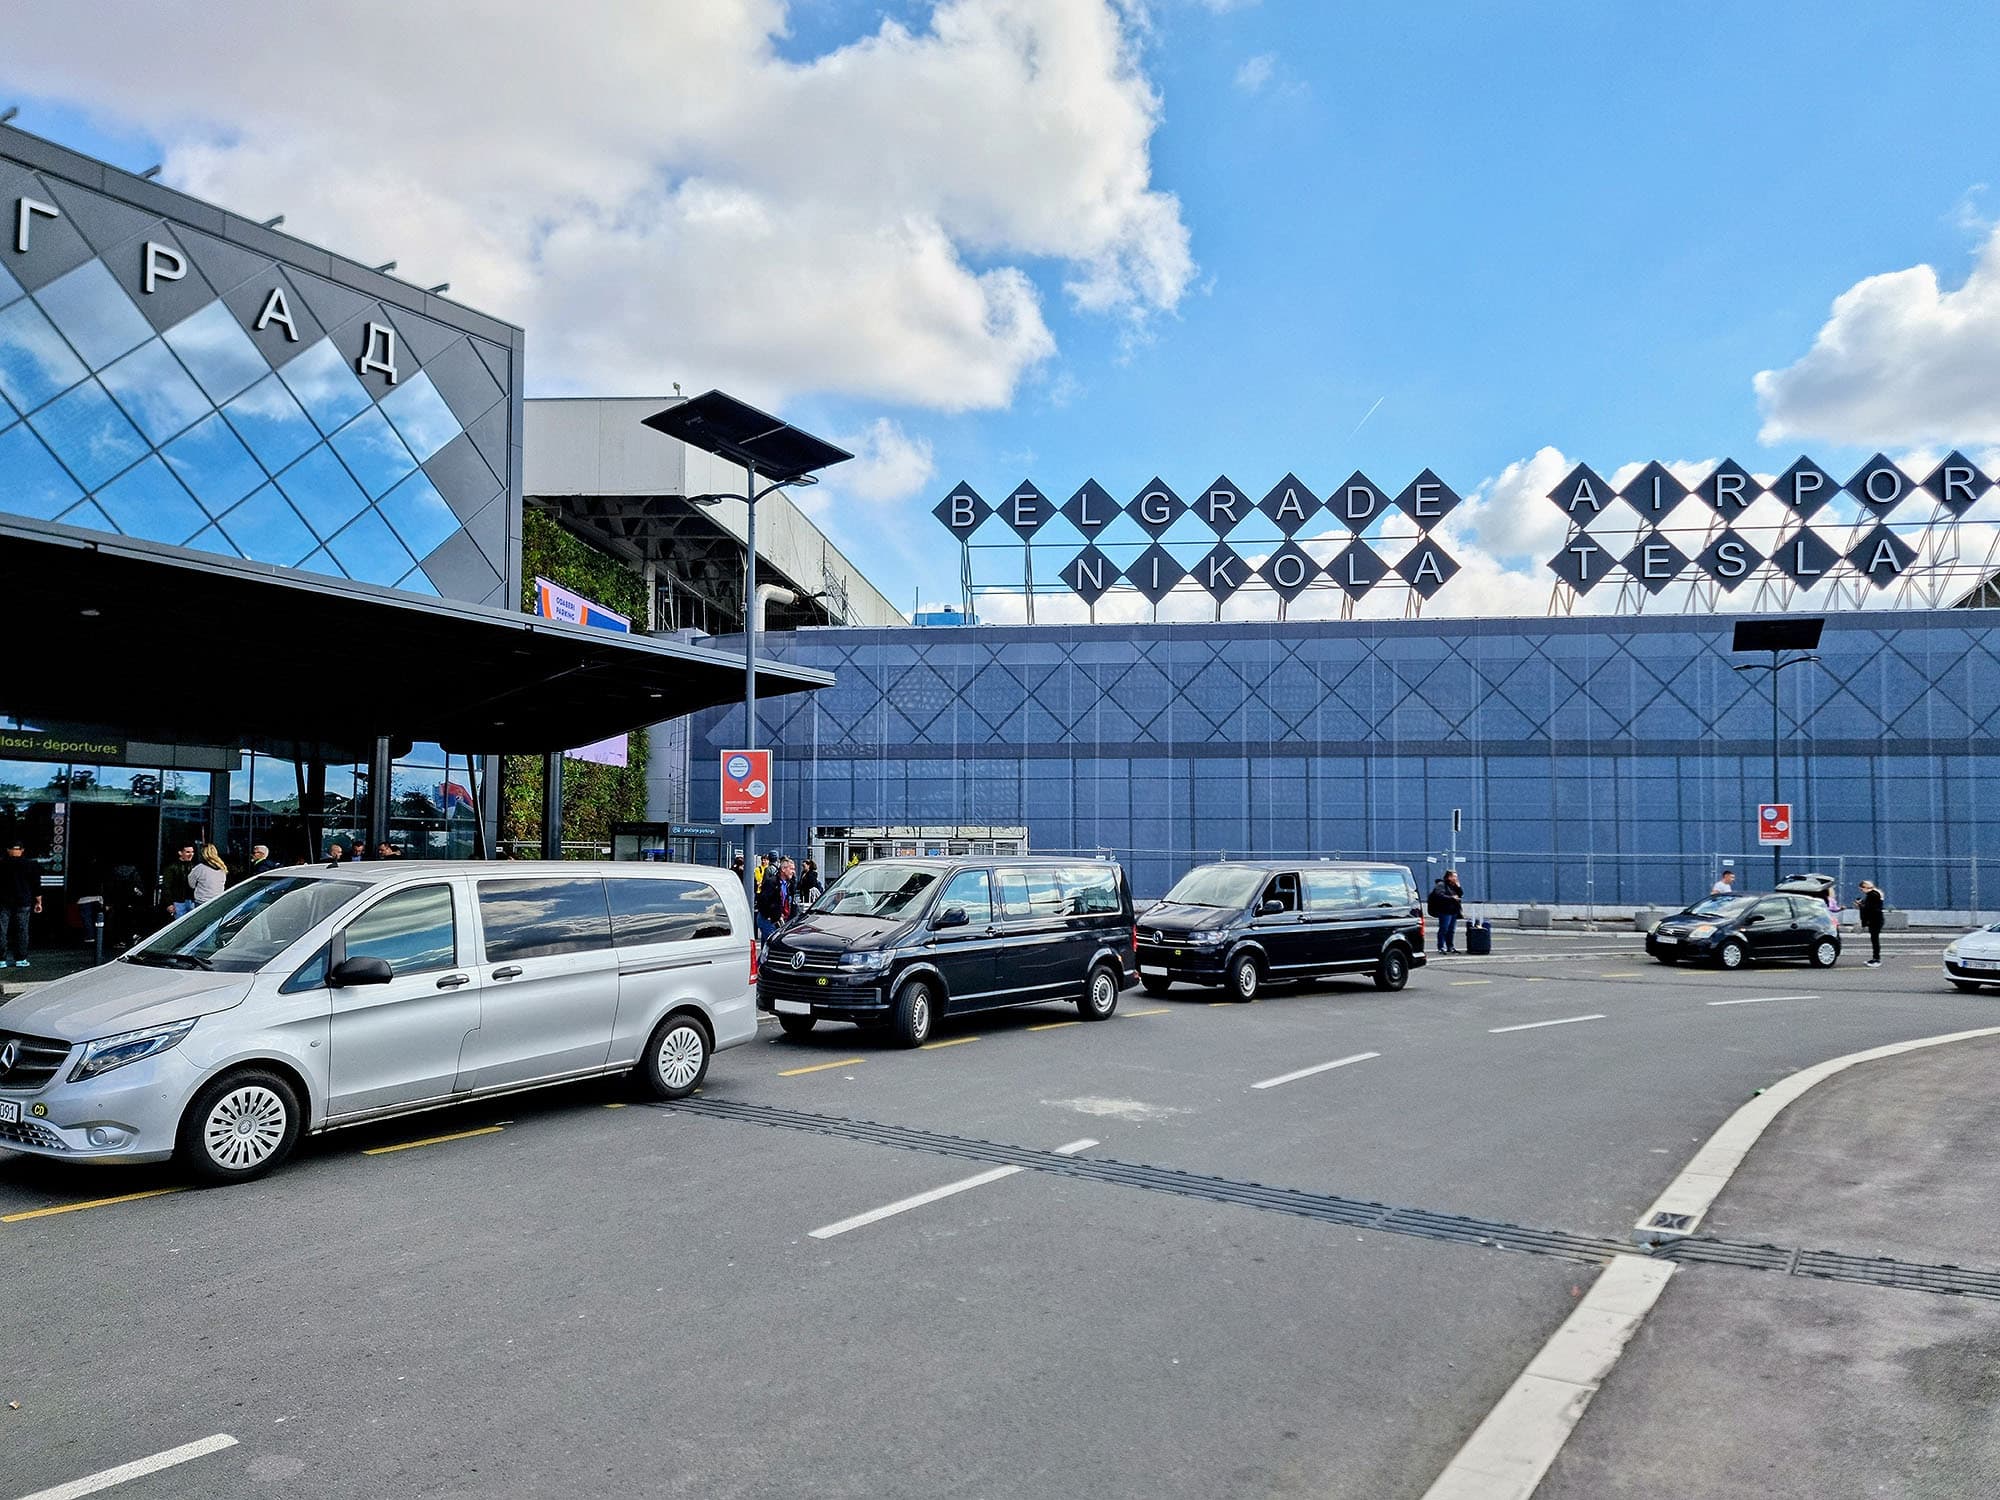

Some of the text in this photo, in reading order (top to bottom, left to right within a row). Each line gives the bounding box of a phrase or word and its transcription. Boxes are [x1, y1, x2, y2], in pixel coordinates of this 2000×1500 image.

[951, 482, 1442, 528] BELGRADE
[1076, 538, 1904, 589] NIKOLA TESLA
[43, 739, 118, 754] departures
[34, 1105, 45, 1116] CD
